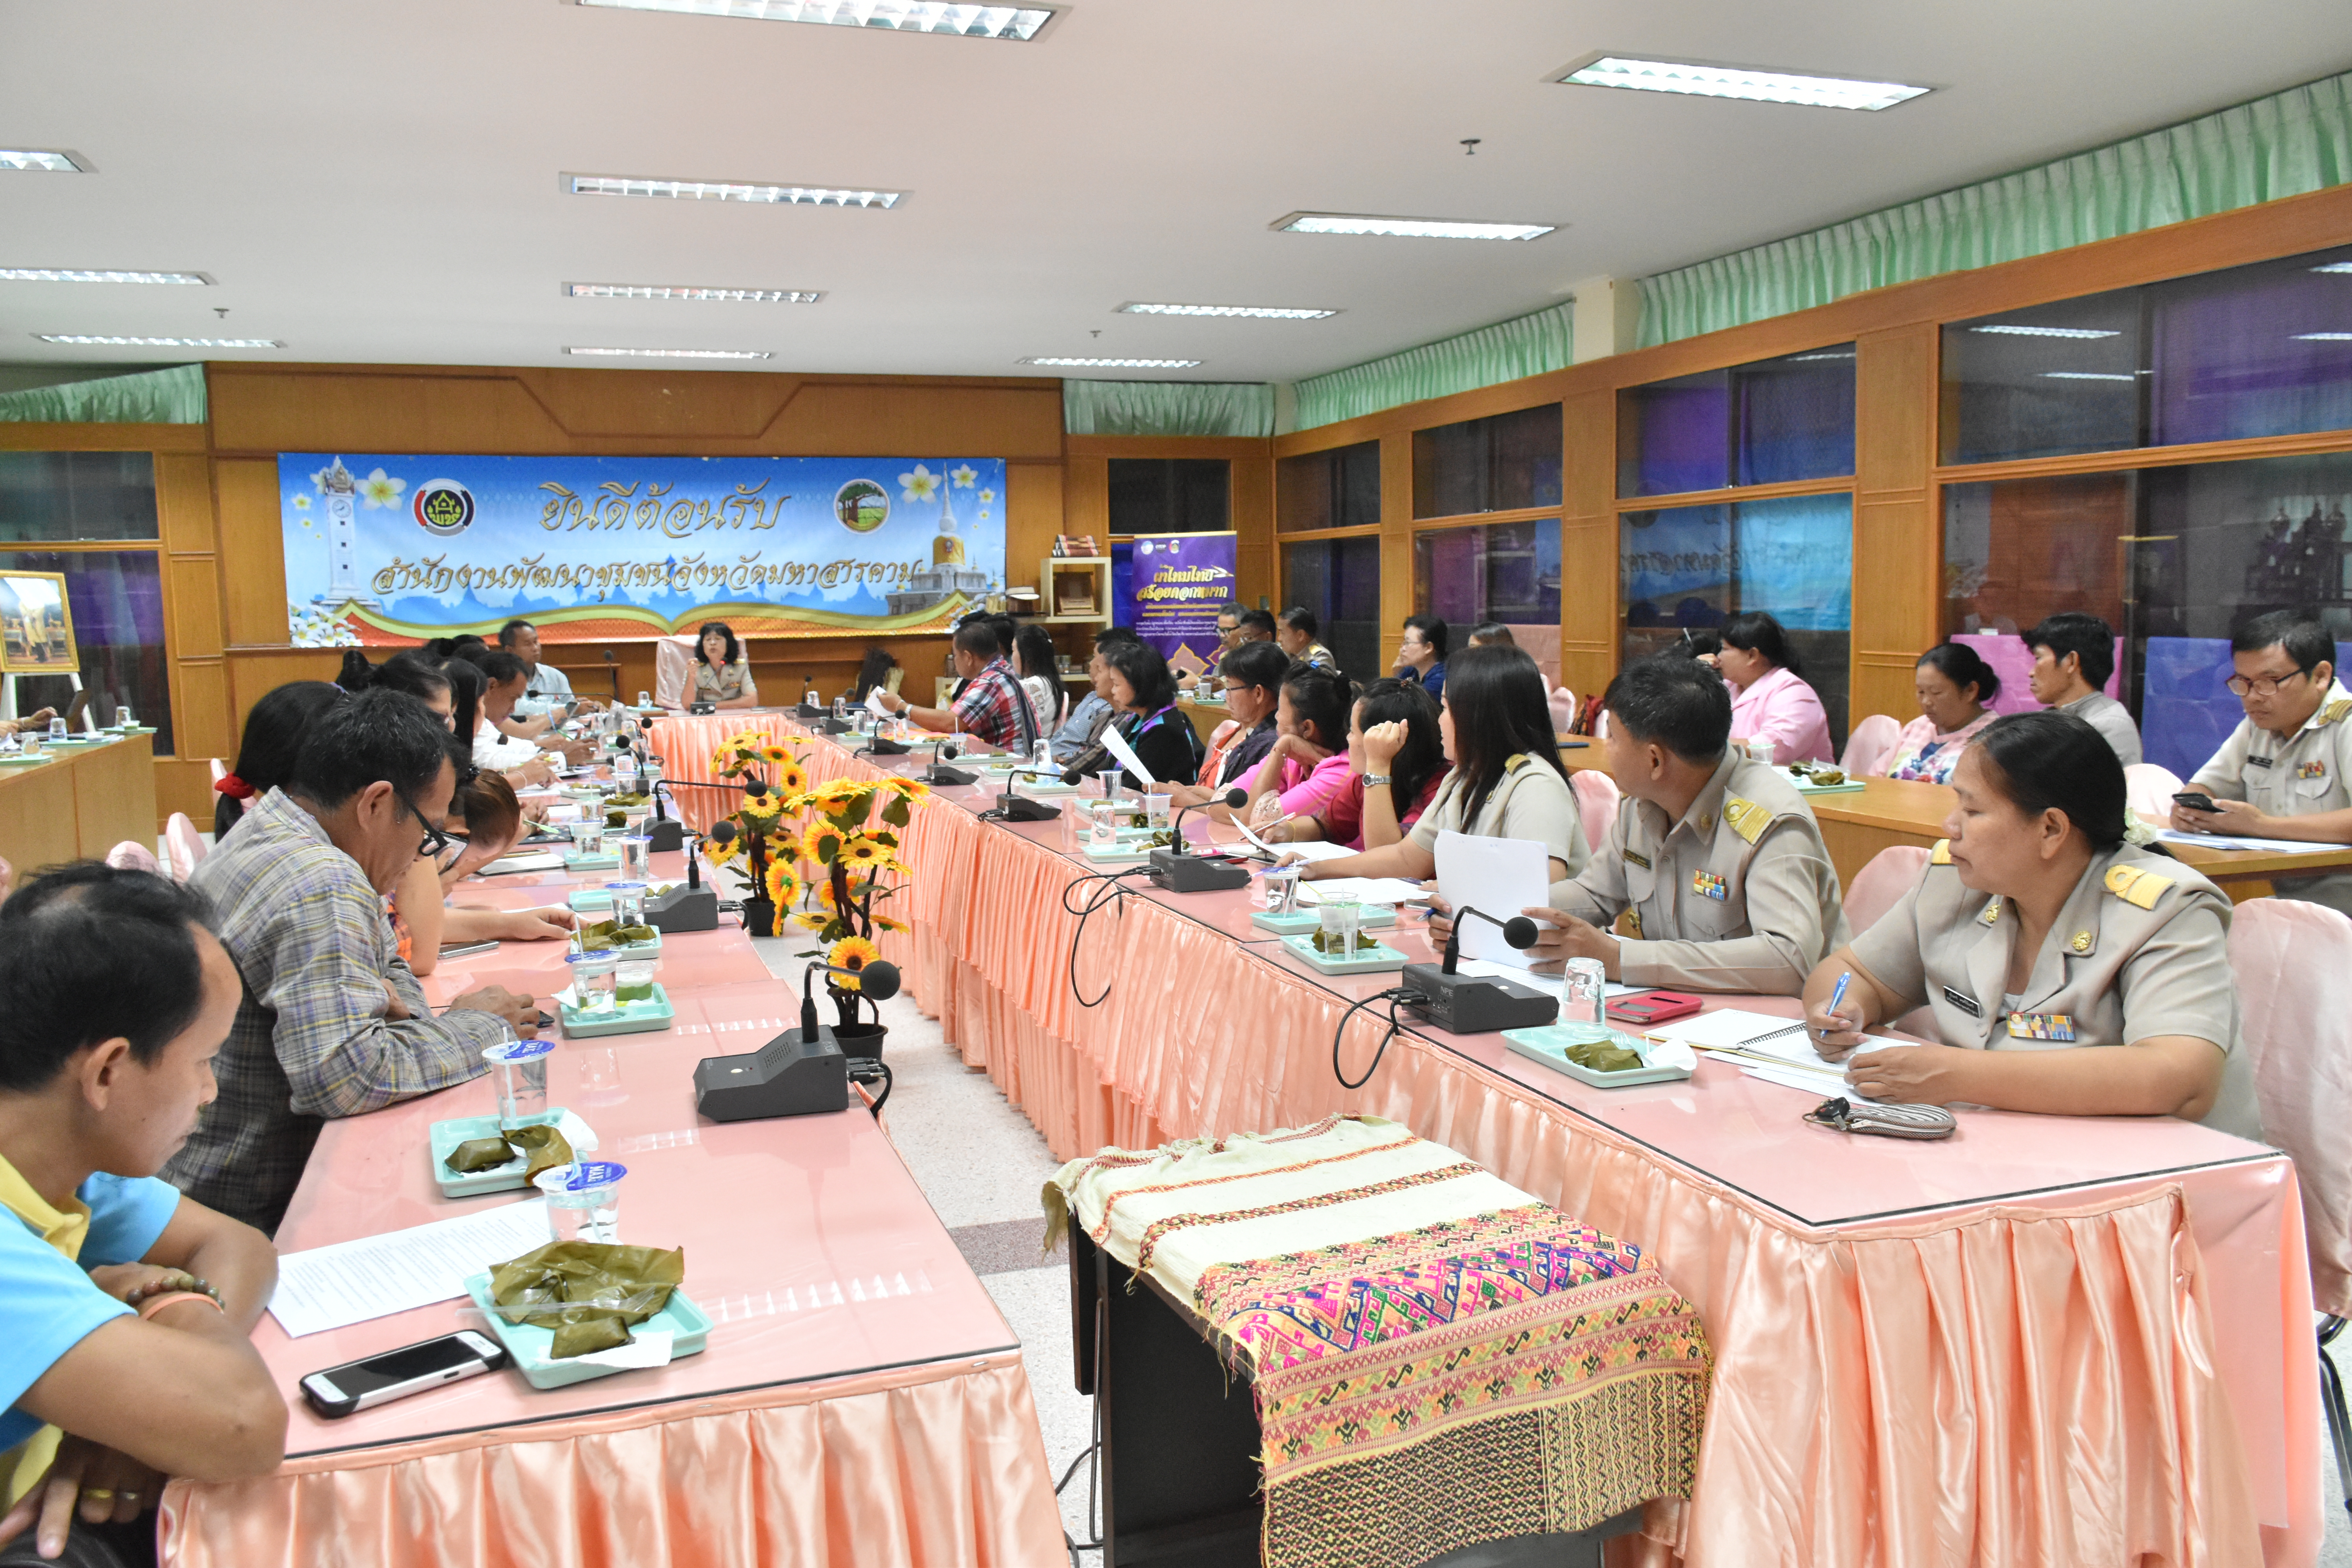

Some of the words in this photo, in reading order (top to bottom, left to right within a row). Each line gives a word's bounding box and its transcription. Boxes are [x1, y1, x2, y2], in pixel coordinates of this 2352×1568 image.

[538, 477, 791, 538] ยินดีต้อนรับ
[371, 550, 923, 602] สำนักงานพัฒนาชุมชนจังหวัดมหาสารคาม
